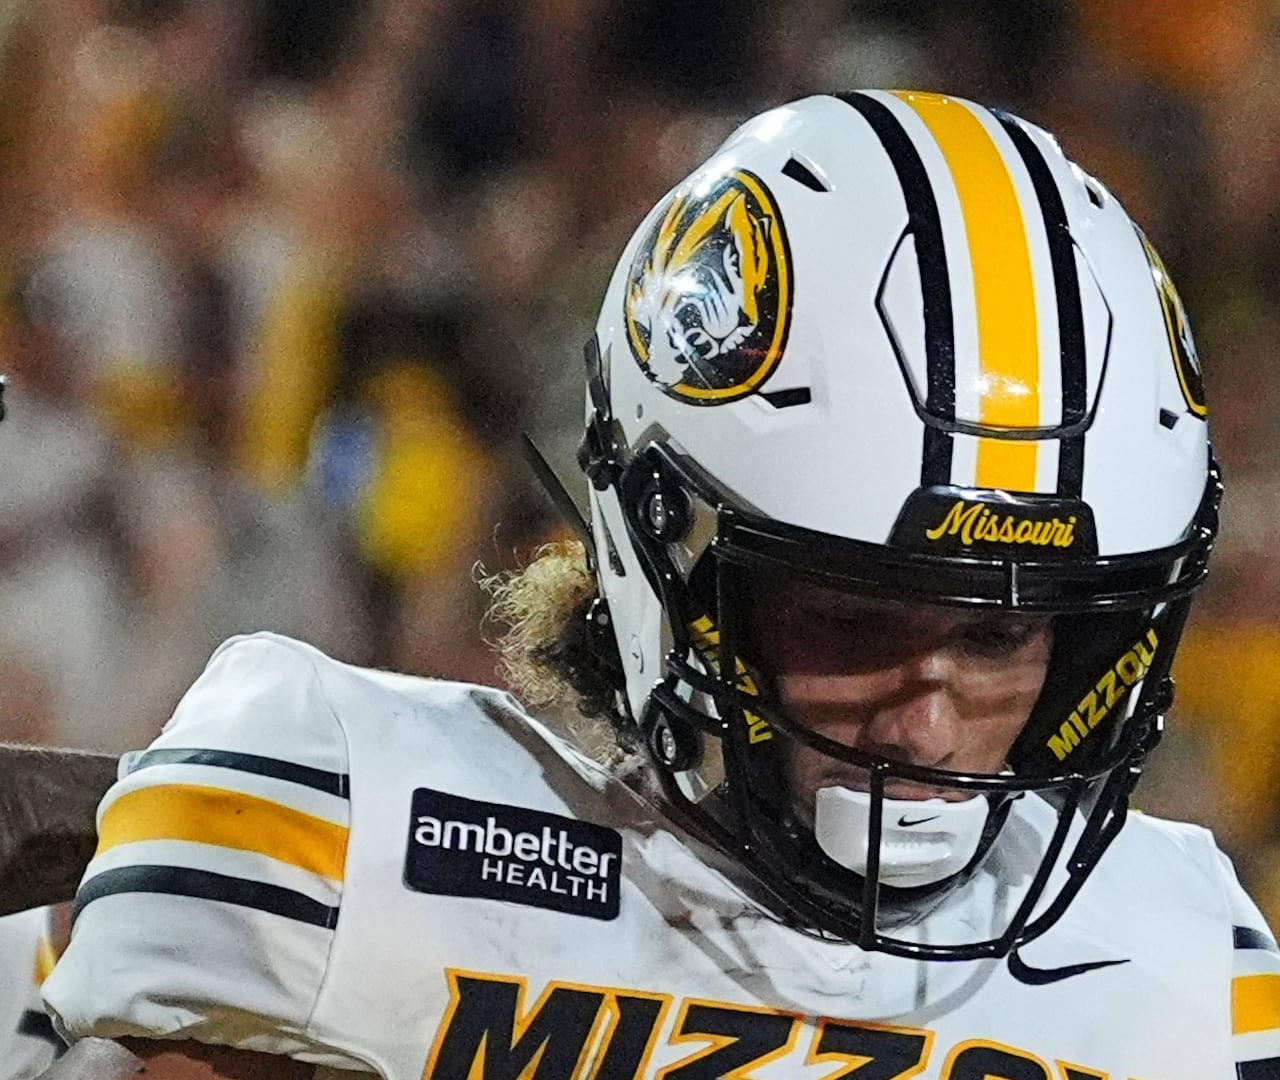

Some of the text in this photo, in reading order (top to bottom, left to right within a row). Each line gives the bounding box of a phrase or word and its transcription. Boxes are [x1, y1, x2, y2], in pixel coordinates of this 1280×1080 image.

[926, 501, 1077, 548] Missouri
[1046, 628, 1159, 761] MIZZOU
[414, 816, 617, 878] ambetter
[481, 858, 608, 903] HEALTH
